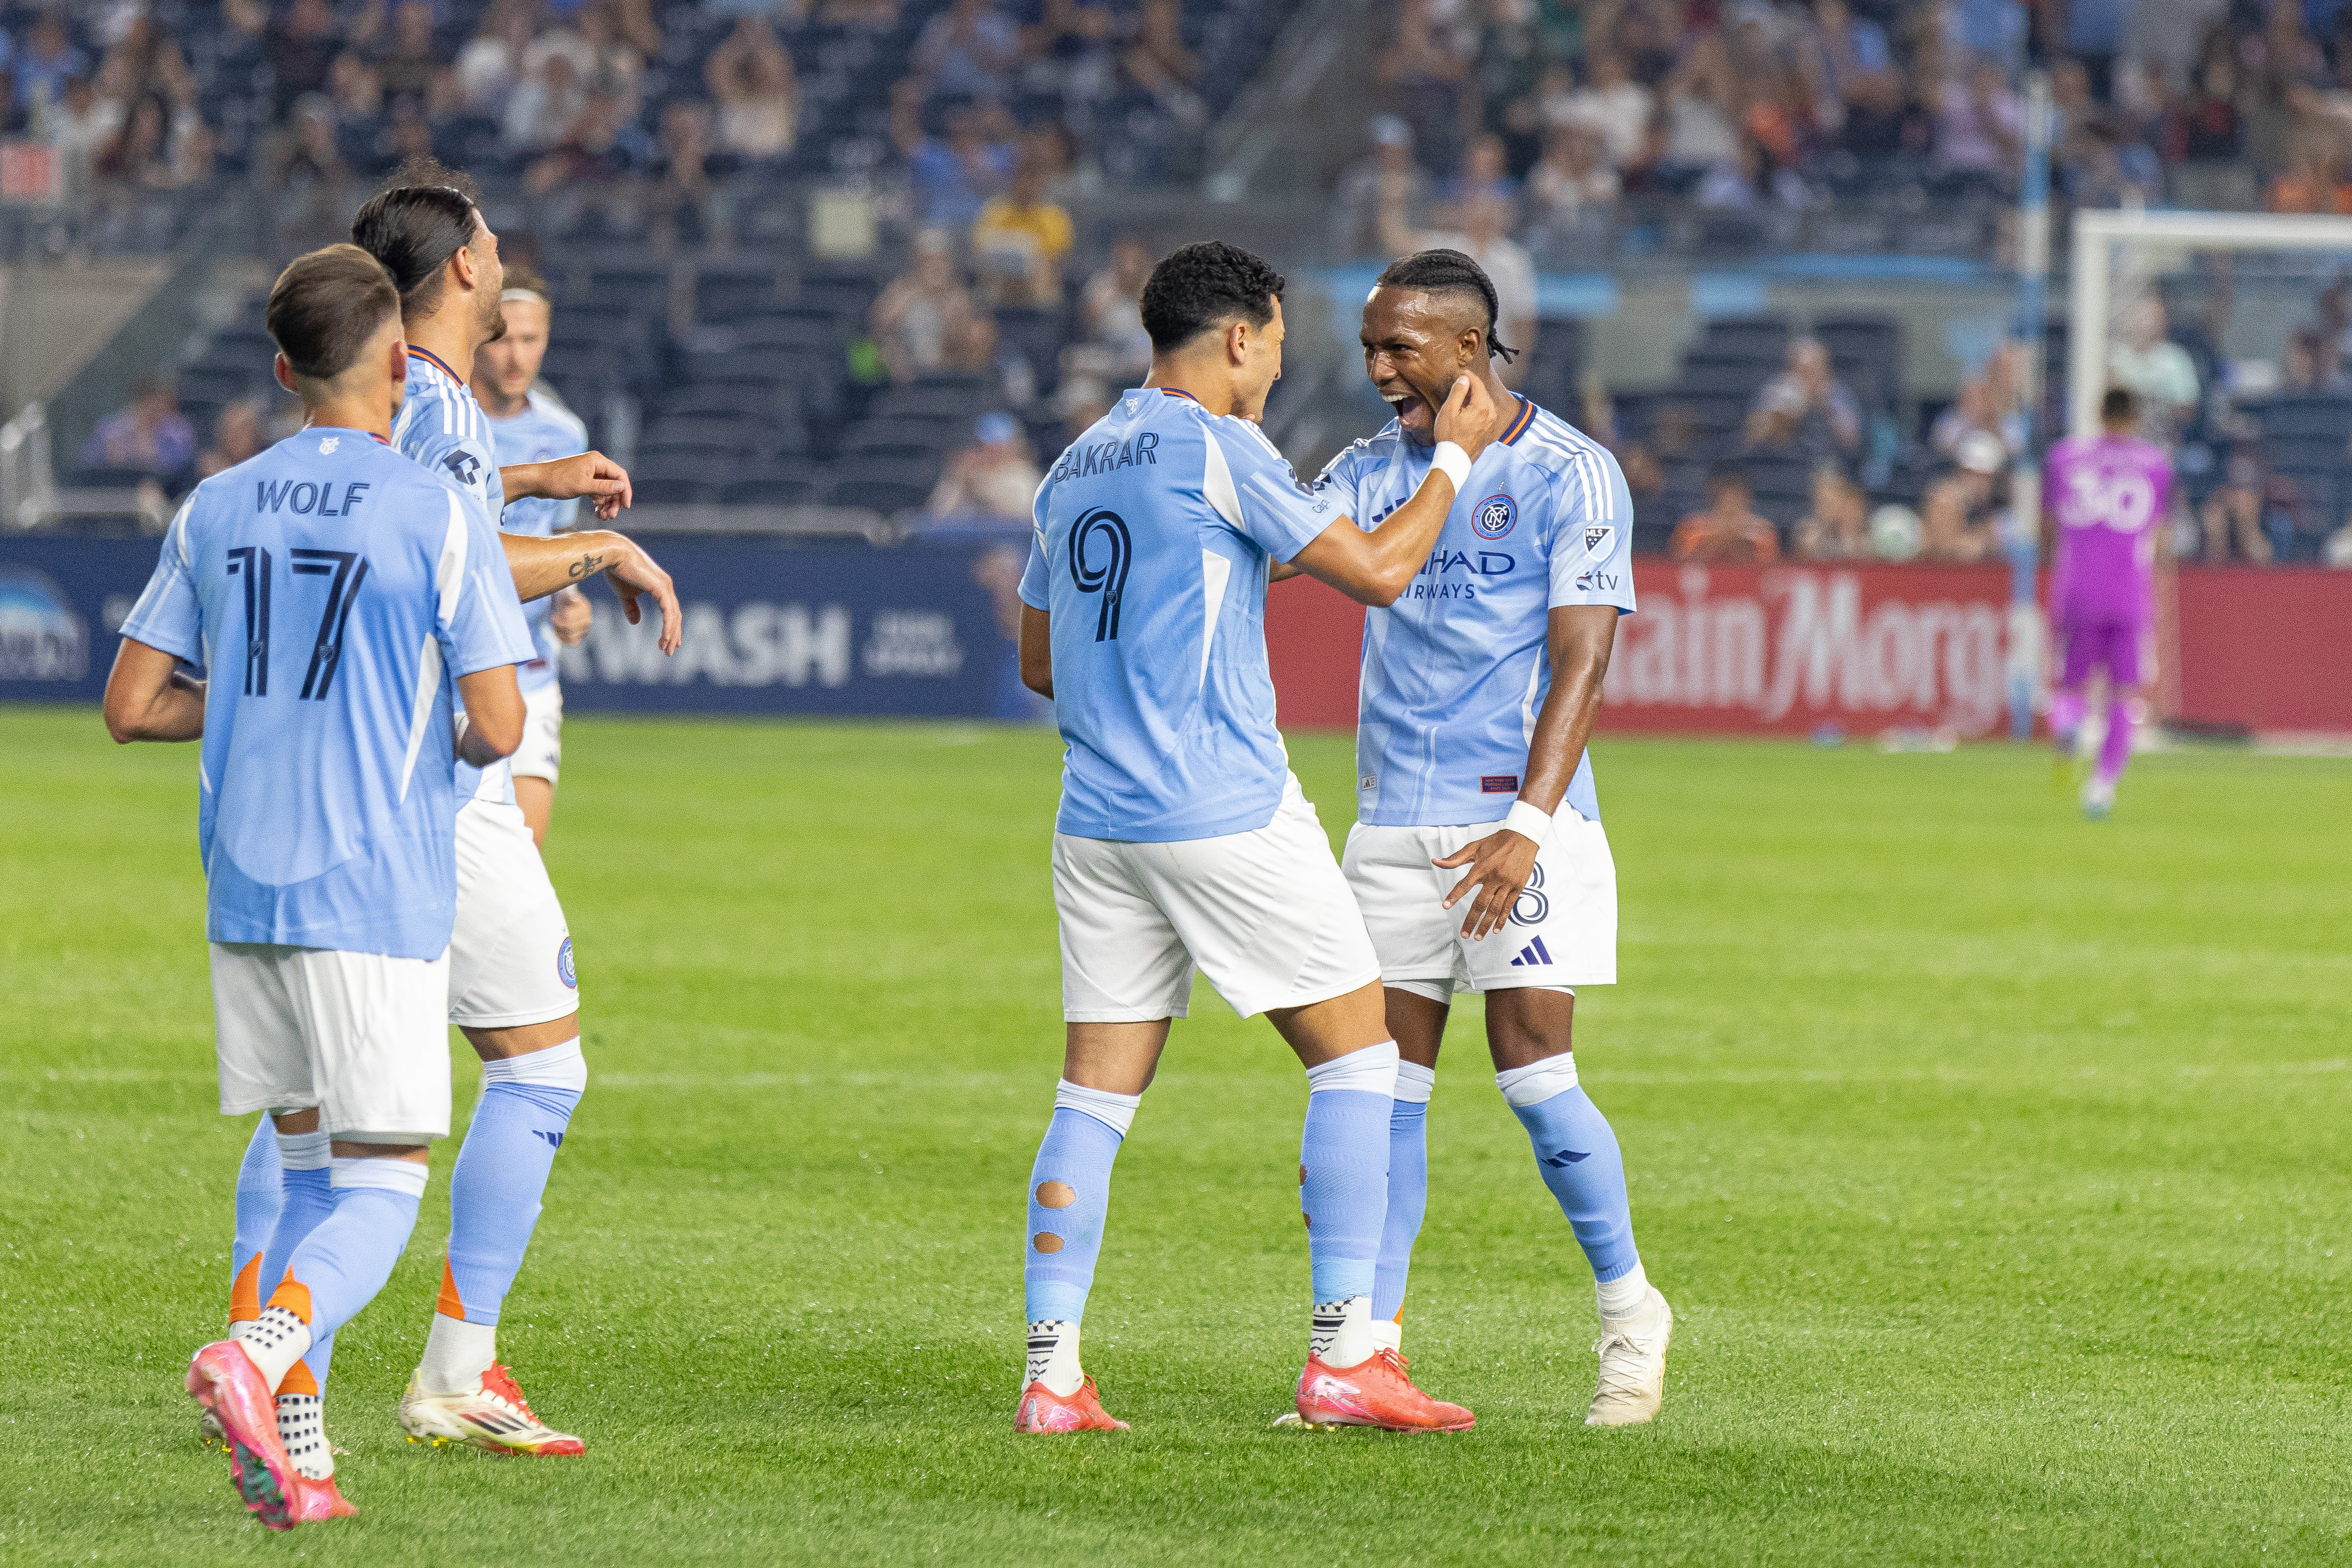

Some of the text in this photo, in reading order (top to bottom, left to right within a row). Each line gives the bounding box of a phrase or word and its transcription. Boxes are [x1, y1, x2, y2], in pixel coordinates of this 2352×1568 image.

[1054, 432, 1159, 484] BAKRAR
[257, 479, 371, 517] WOLF
[2058, 470, 2154, 532] 30
[1586, 528, 1603, 537] MLS
[1068, 505, 1132, 643] 9
[1400, 583, 1475, 600] IRWAYS
[226, 546, 371, 701] 17
[1508, 860, 1549, 928] 8
